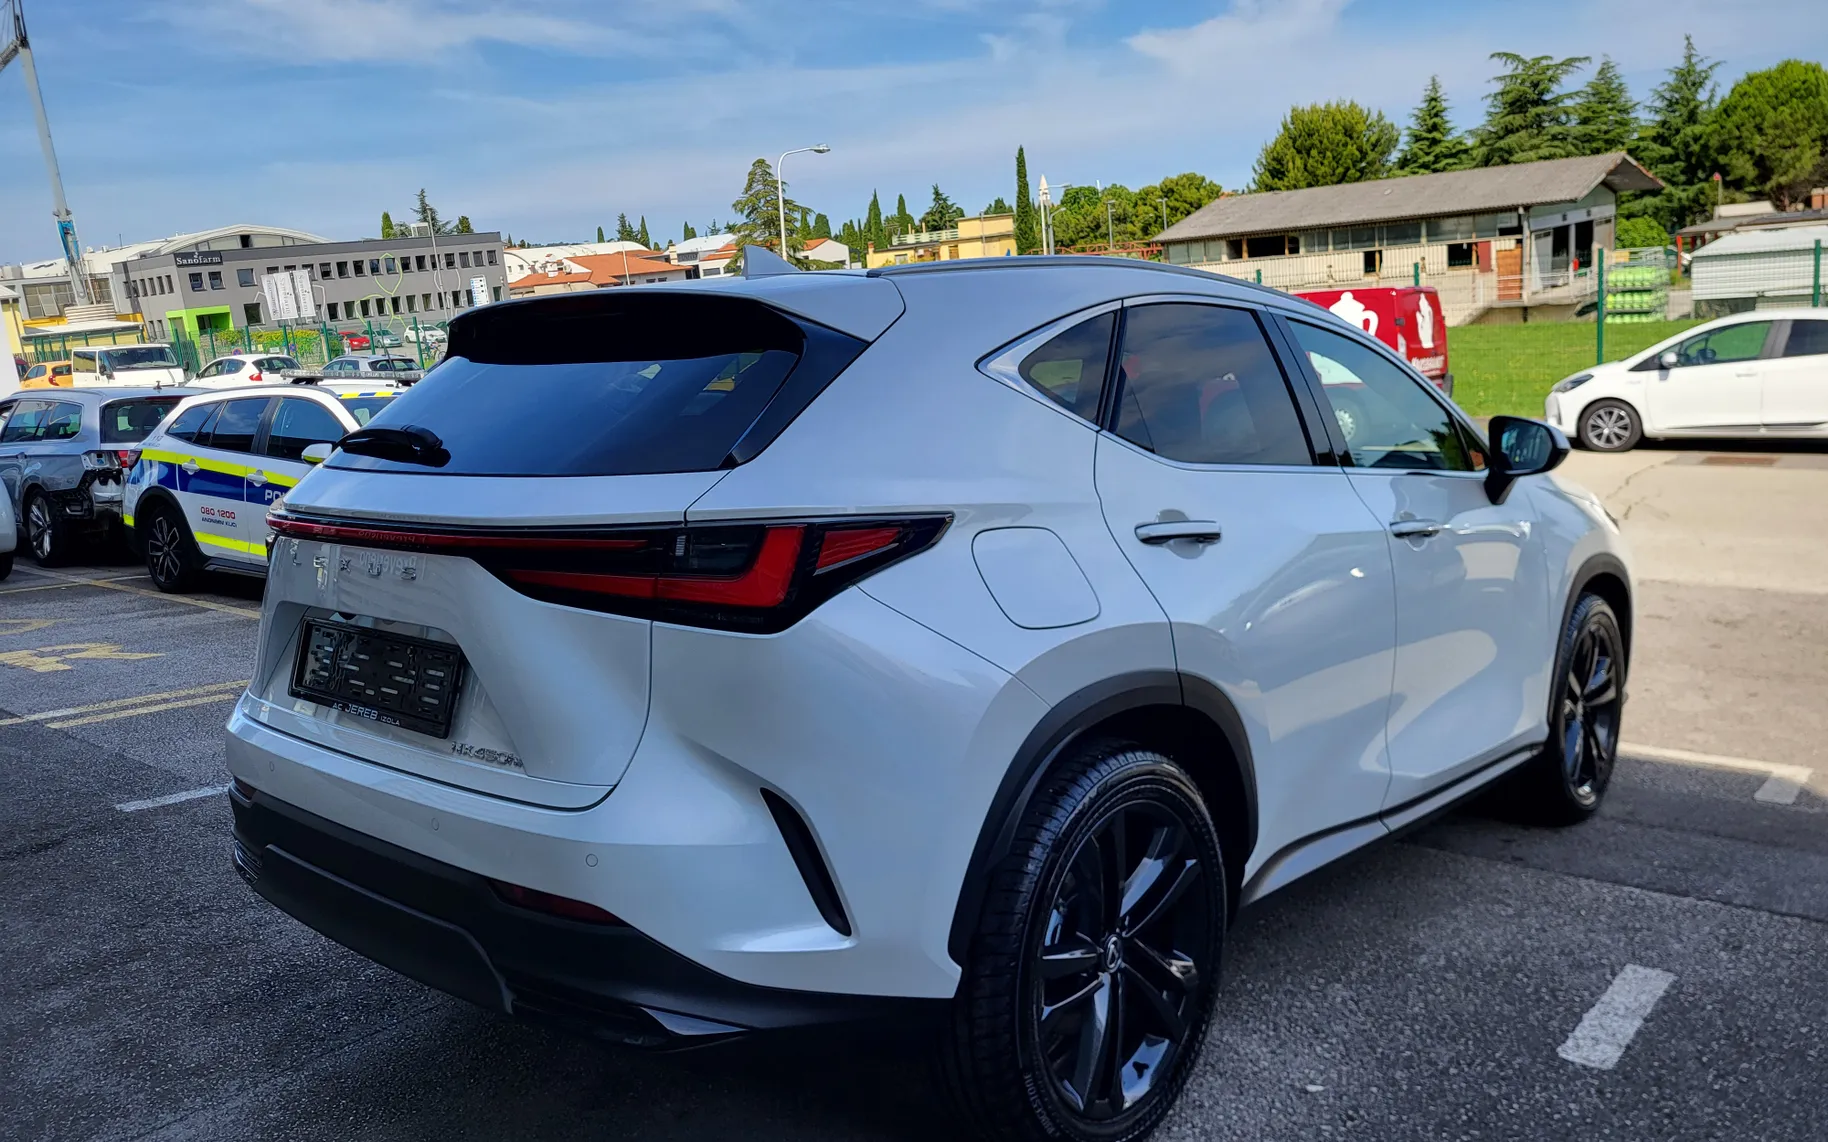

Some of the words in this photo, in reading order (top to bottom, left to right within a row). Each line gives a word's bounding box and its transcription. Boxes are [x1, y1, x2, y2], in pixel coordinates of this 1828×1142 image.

[176, 255, 221, 265] Sanofarm
[200, 506, 215, 516] 080
[217, 509, 236, 520] 1200
[332, 702, 343, 710] AC
[344, 704, 378, 720] JEREB
[380, 715, 400, 726] IZOLA
